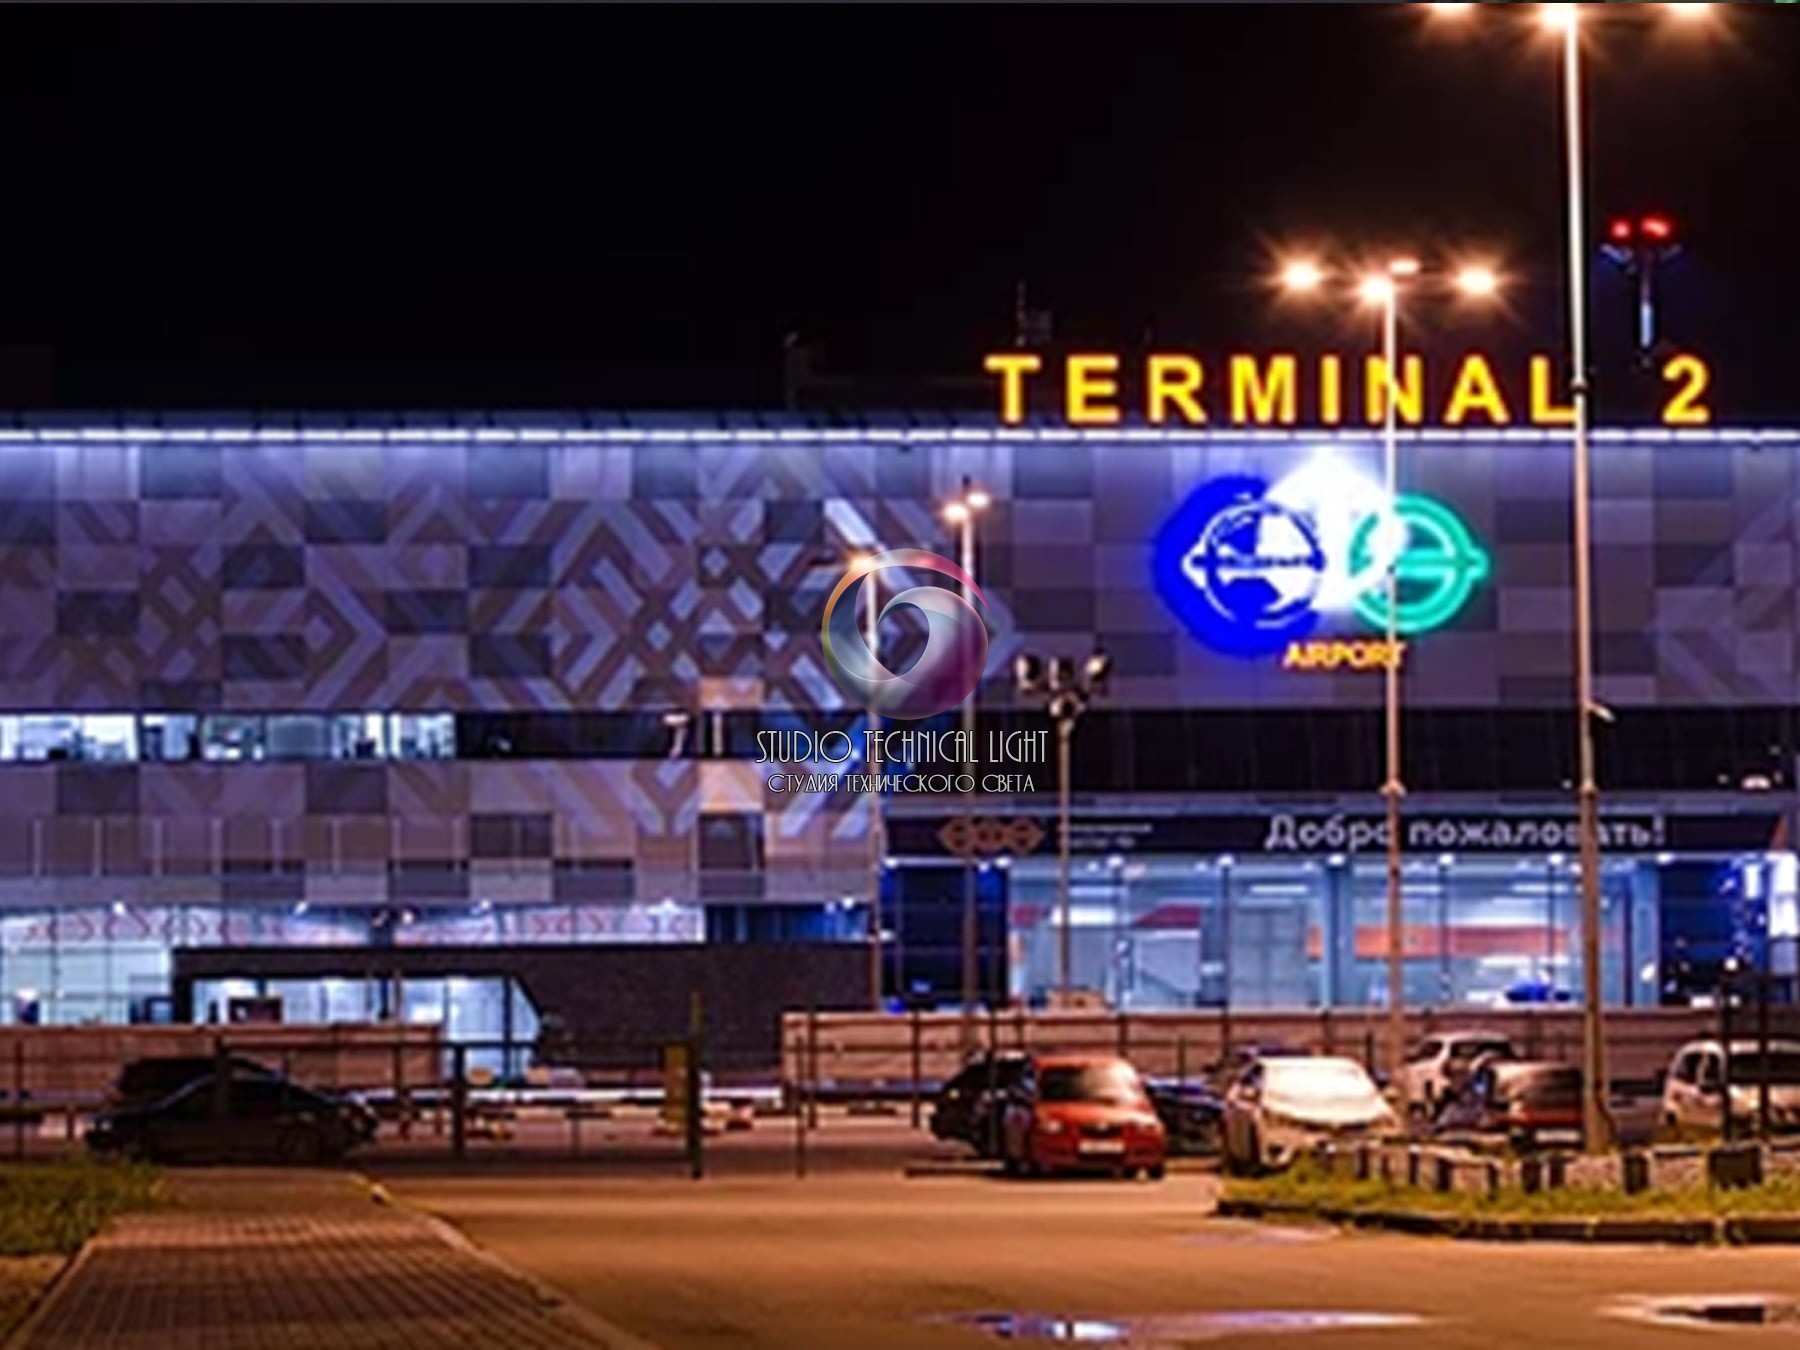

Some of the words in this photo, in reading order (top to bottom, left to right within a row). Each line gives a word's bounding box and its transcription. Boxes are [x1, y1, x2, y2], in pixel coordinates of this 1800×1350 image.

[985, 355, 1579, 423] TERMINAL
[1662, 355, 1710, 423] 2
[1282, 641, 1407, 668] AIRPORT
